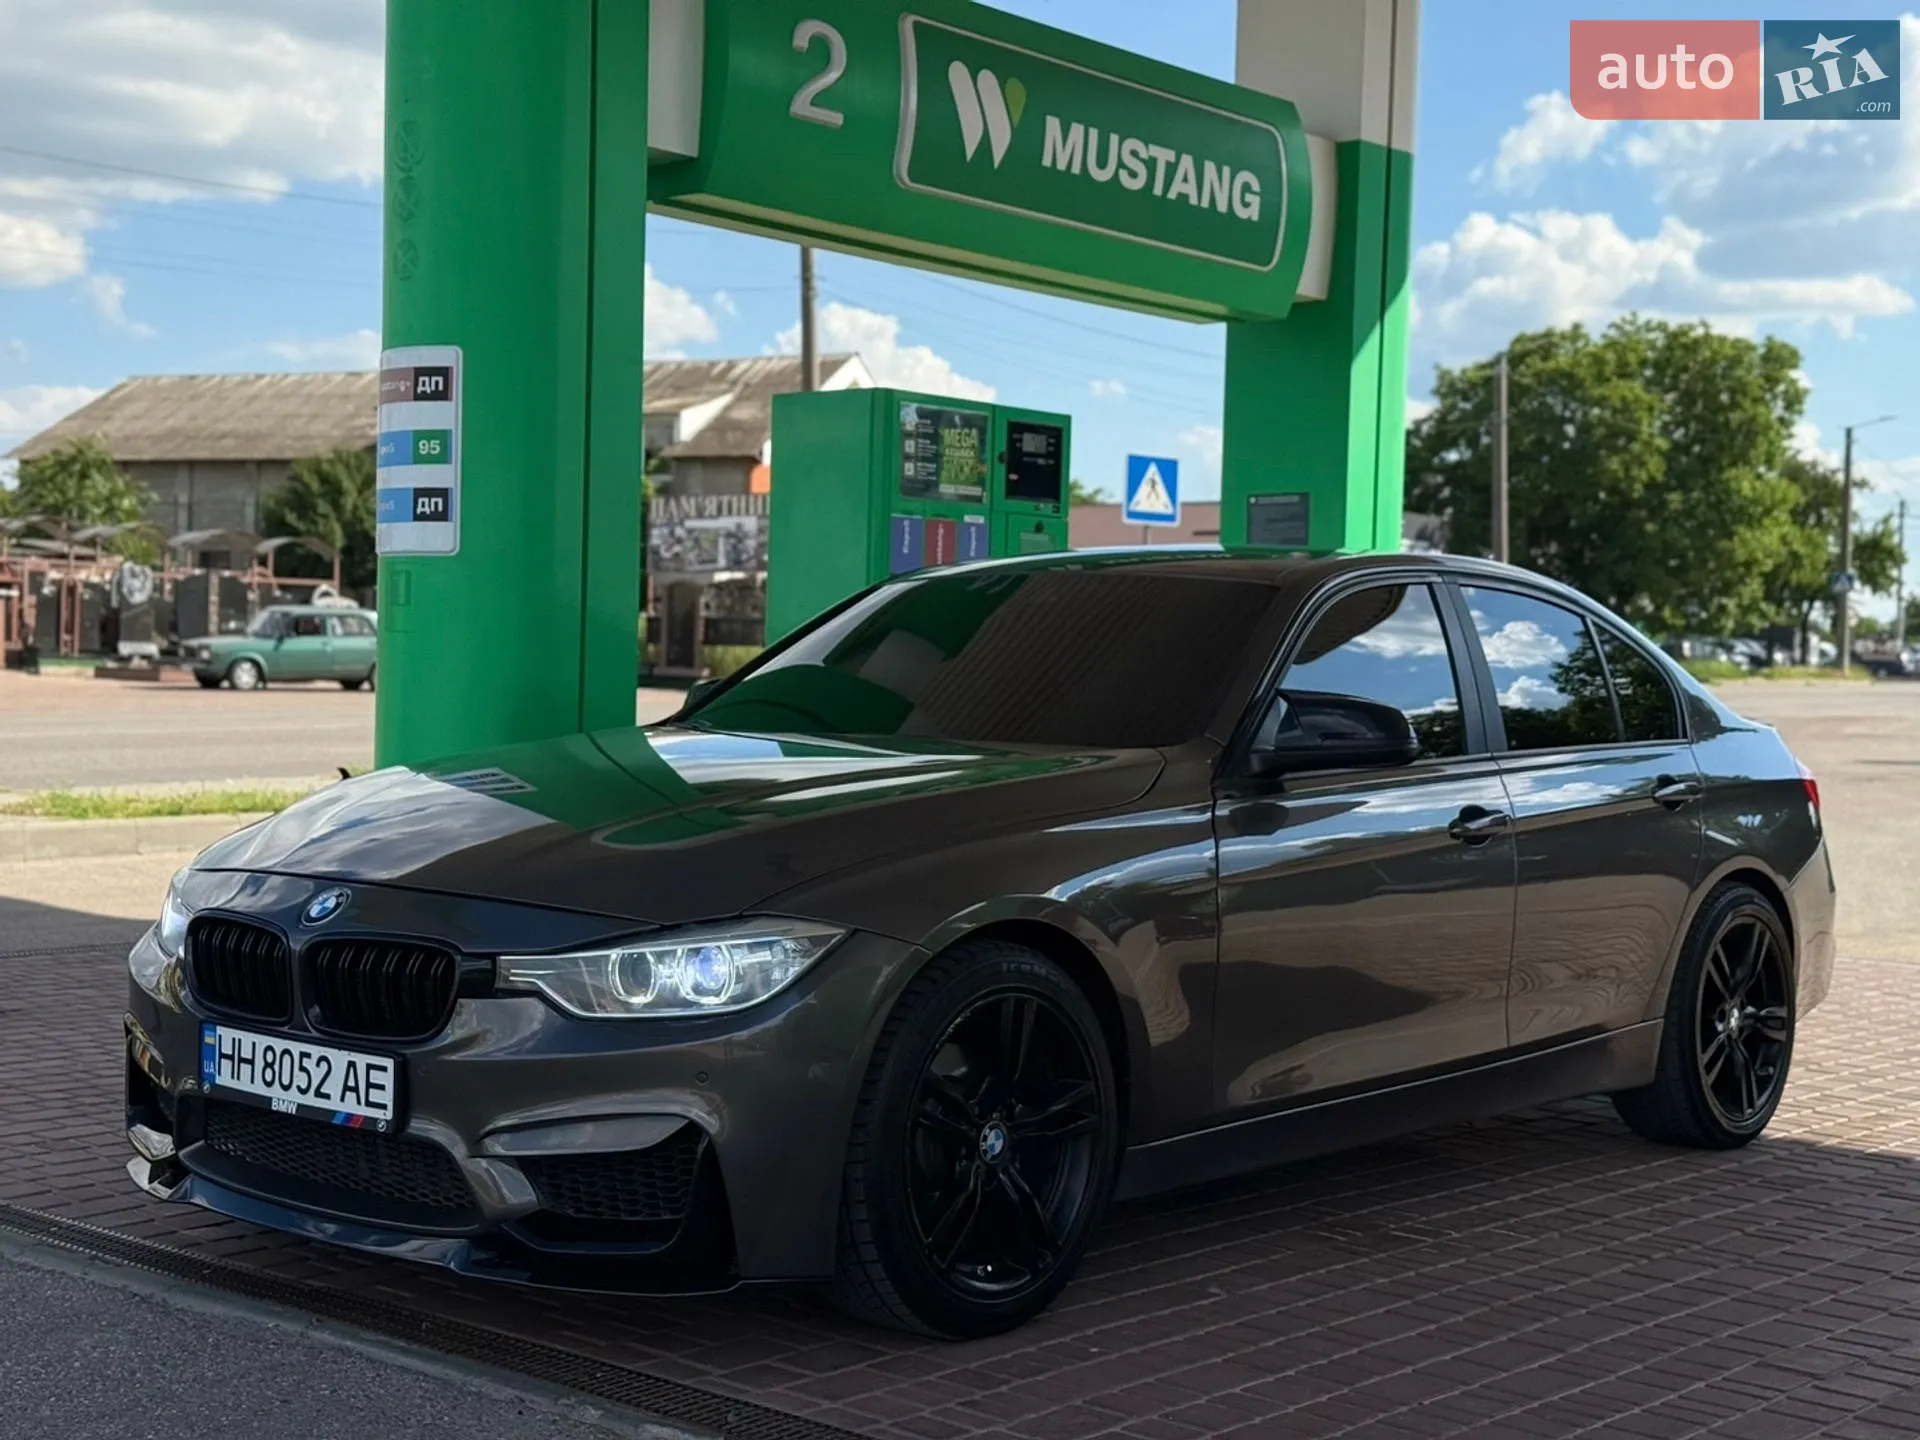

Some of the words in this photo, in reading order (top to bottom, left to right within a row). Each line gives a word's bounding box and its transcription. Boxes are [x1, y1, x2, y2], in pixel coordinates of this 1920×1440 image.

[789, 18, 848, 128] 2
[1041, 114, 1262, 222] MUSTANG
[417, 375, 444, 394] ДП
[418, 439, 441, 455] 95
[416, 497, 443, 515] ДП
[203, 1059, 215, 1074] UA
[217, 1033, 257, 1085] HH
[261, 1044, 333, 1101] 8052
[339, 1059, 389, 1111] AE
[271, 1097, 299, 1115] BMW
